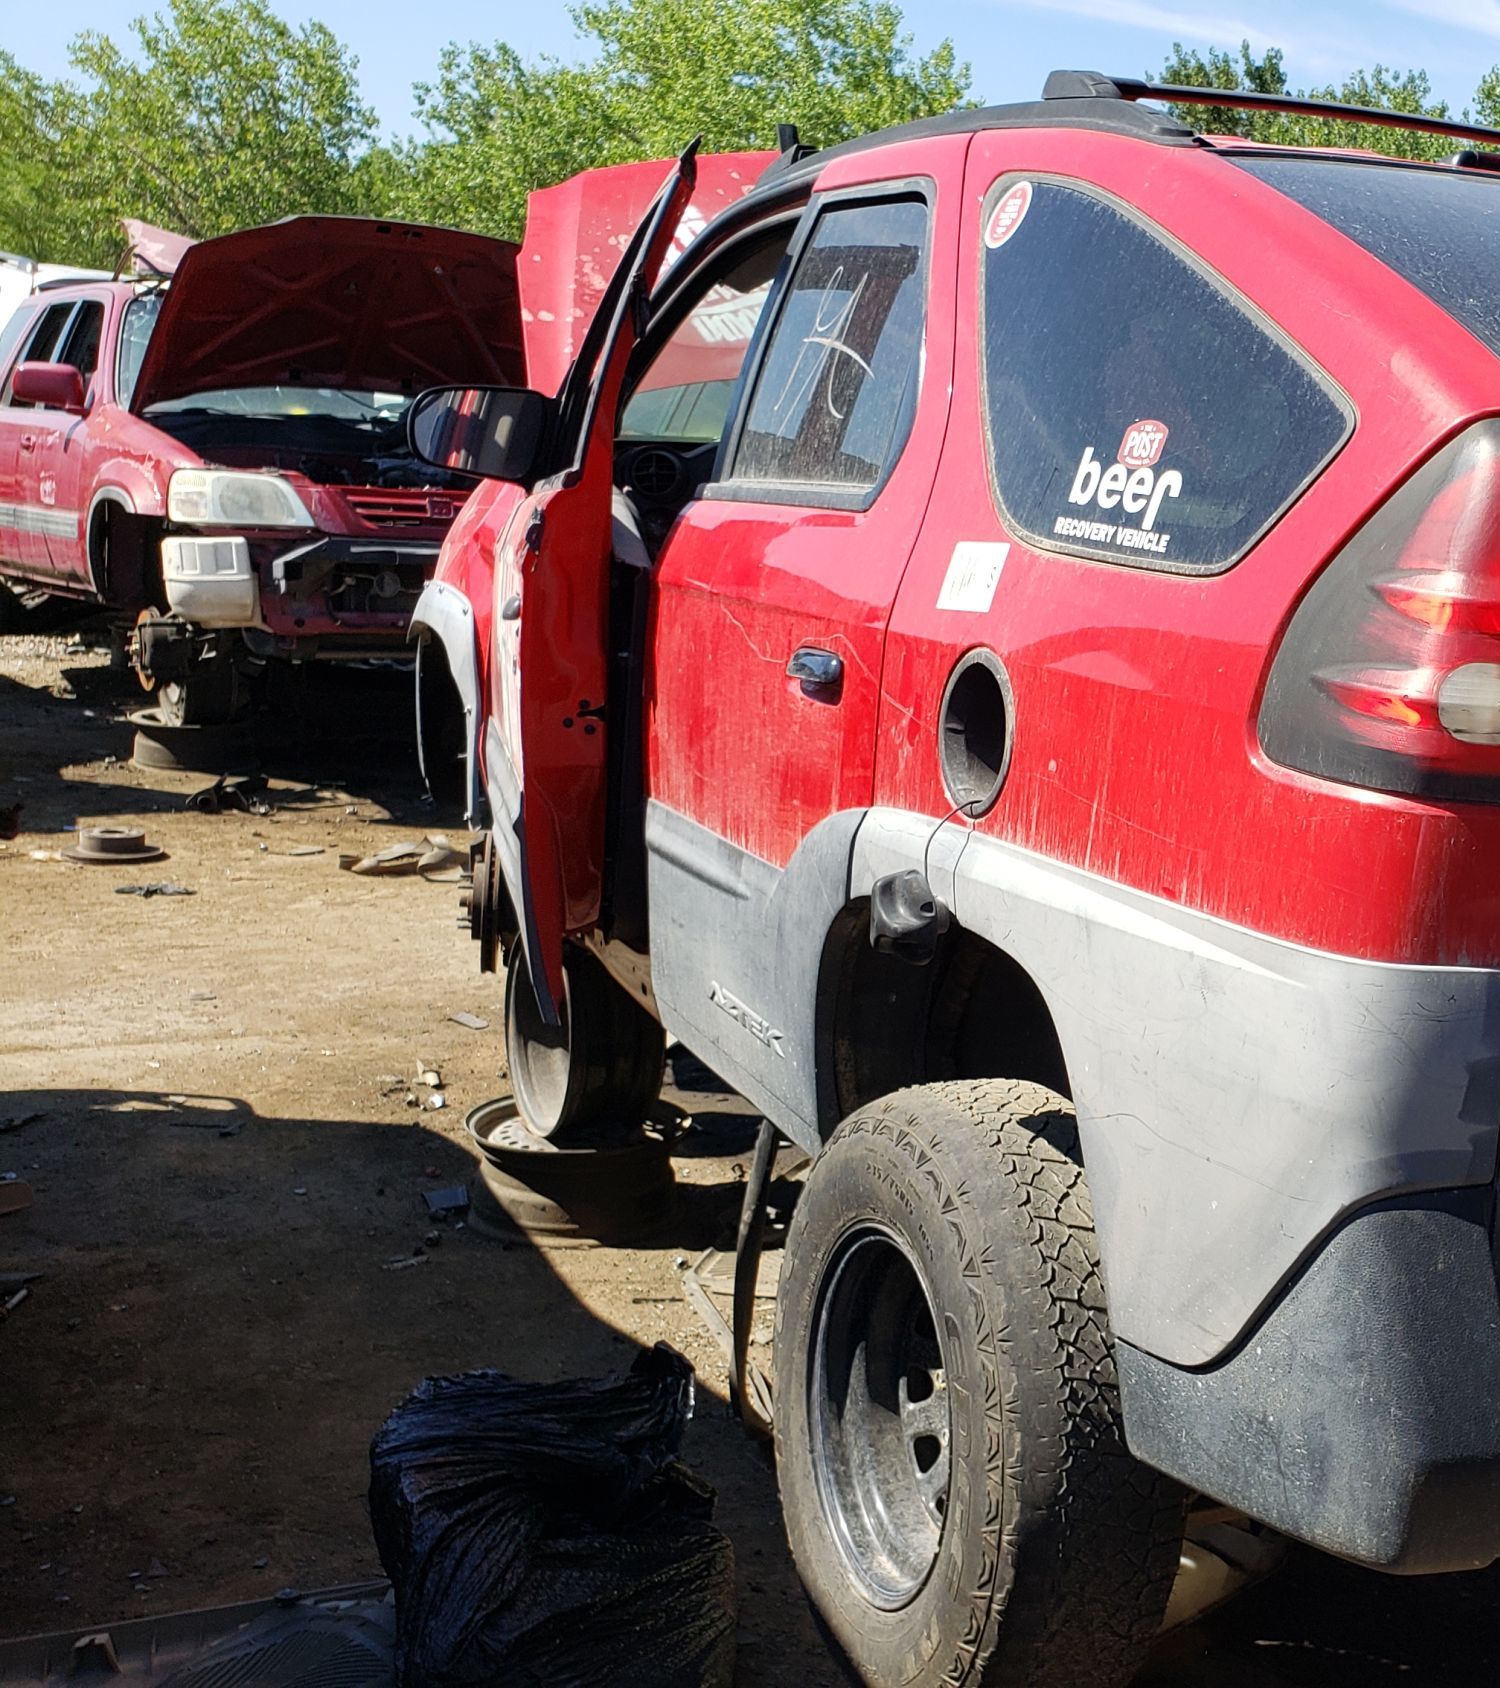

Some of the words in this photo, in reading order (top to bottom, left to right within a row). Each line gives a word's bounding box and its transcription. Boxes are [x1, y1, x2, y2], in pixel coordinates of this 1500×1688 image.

[1123, 430, 1164, 458] POST
[1068, 446, 1183, 531] beer
[1053, 516, 1117, 543] RECOVERY
[1116, 526, 1171, 553] VEHICLE
